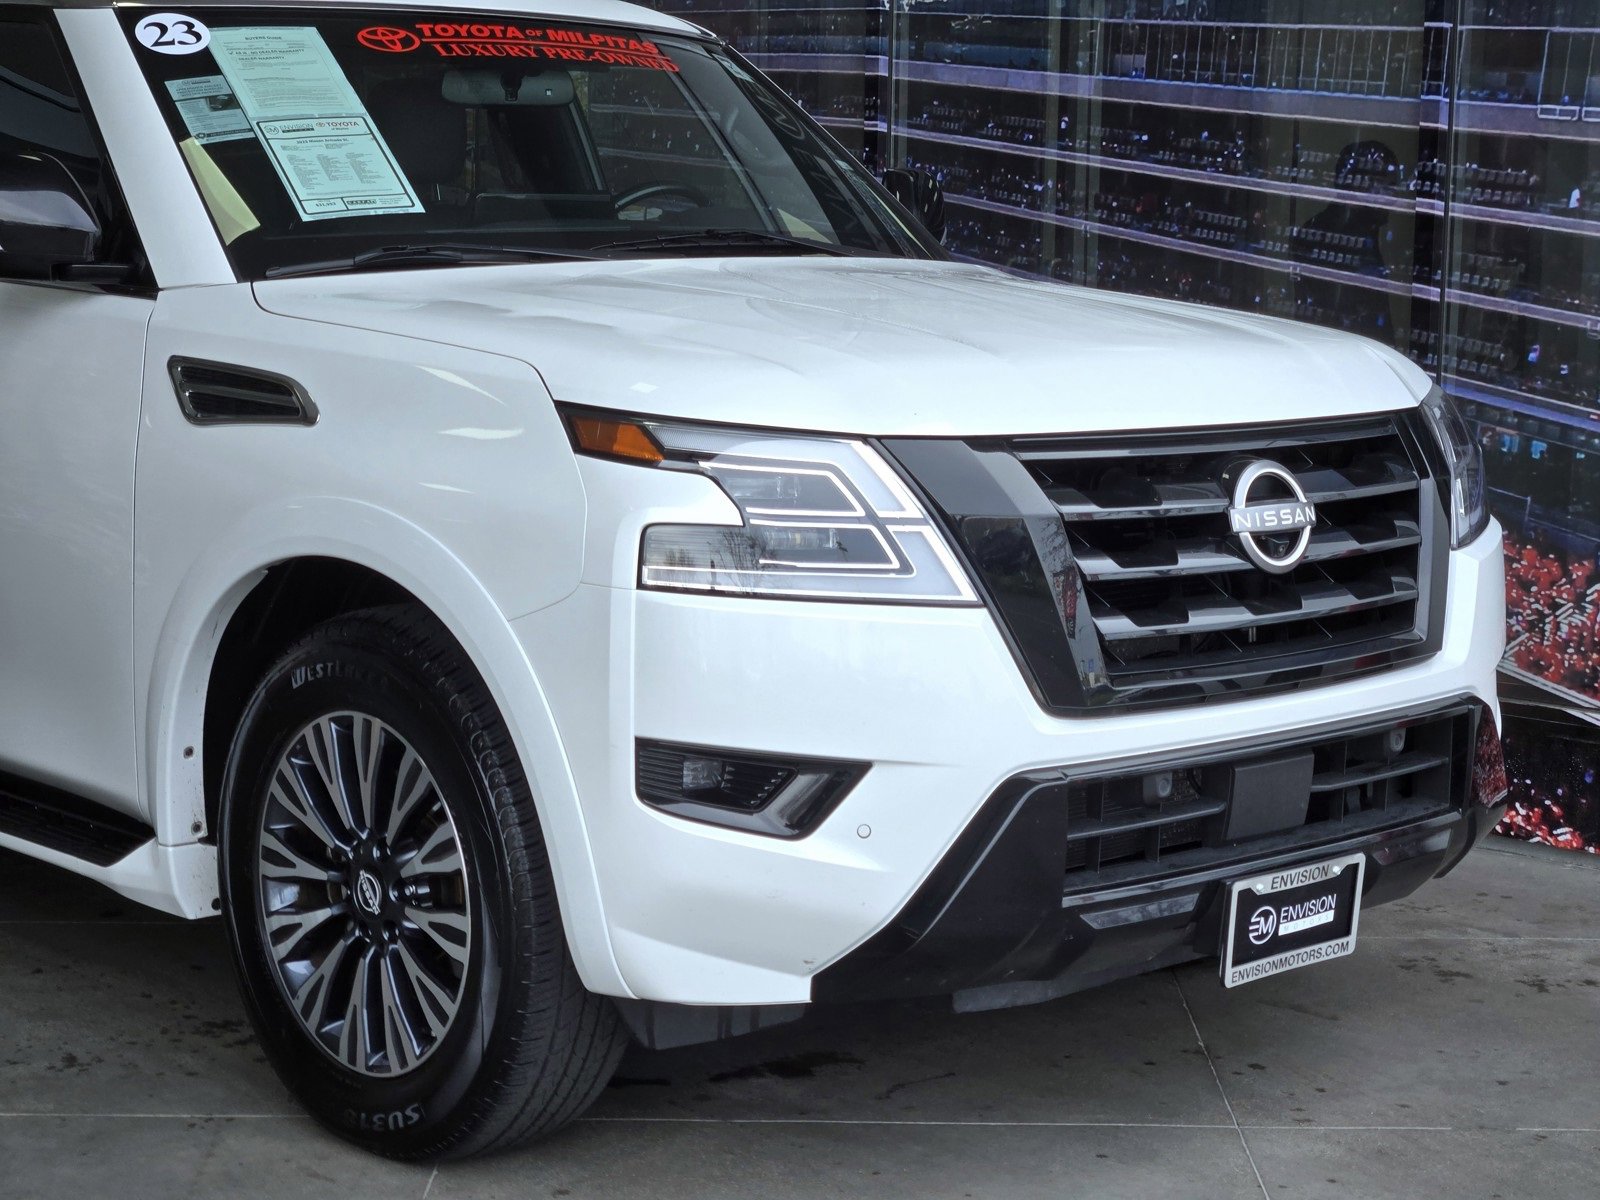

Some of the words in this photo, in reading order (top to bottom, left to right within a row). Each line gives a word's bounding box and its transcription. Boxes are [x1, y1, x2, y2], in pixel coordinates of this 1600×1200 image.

[143, 20, 202, 48] 23
[416, 23, 524, 40] TOYOTA
[526, 28, 543, 38] OF
[546, 28, 660, 55] MILPITAS
[432, 42, 538, 58] LUXURY
[546, 46, 680, 73] PRE-OWNED
[1234, 505, 1316, 530] NISSAN
[1270, 864, 1331, 891] ENVISION
[1280, 893, 1337, 924] ENVISION
[1231, 941, 1350, 984] ENVISIONMOTORS.COM
